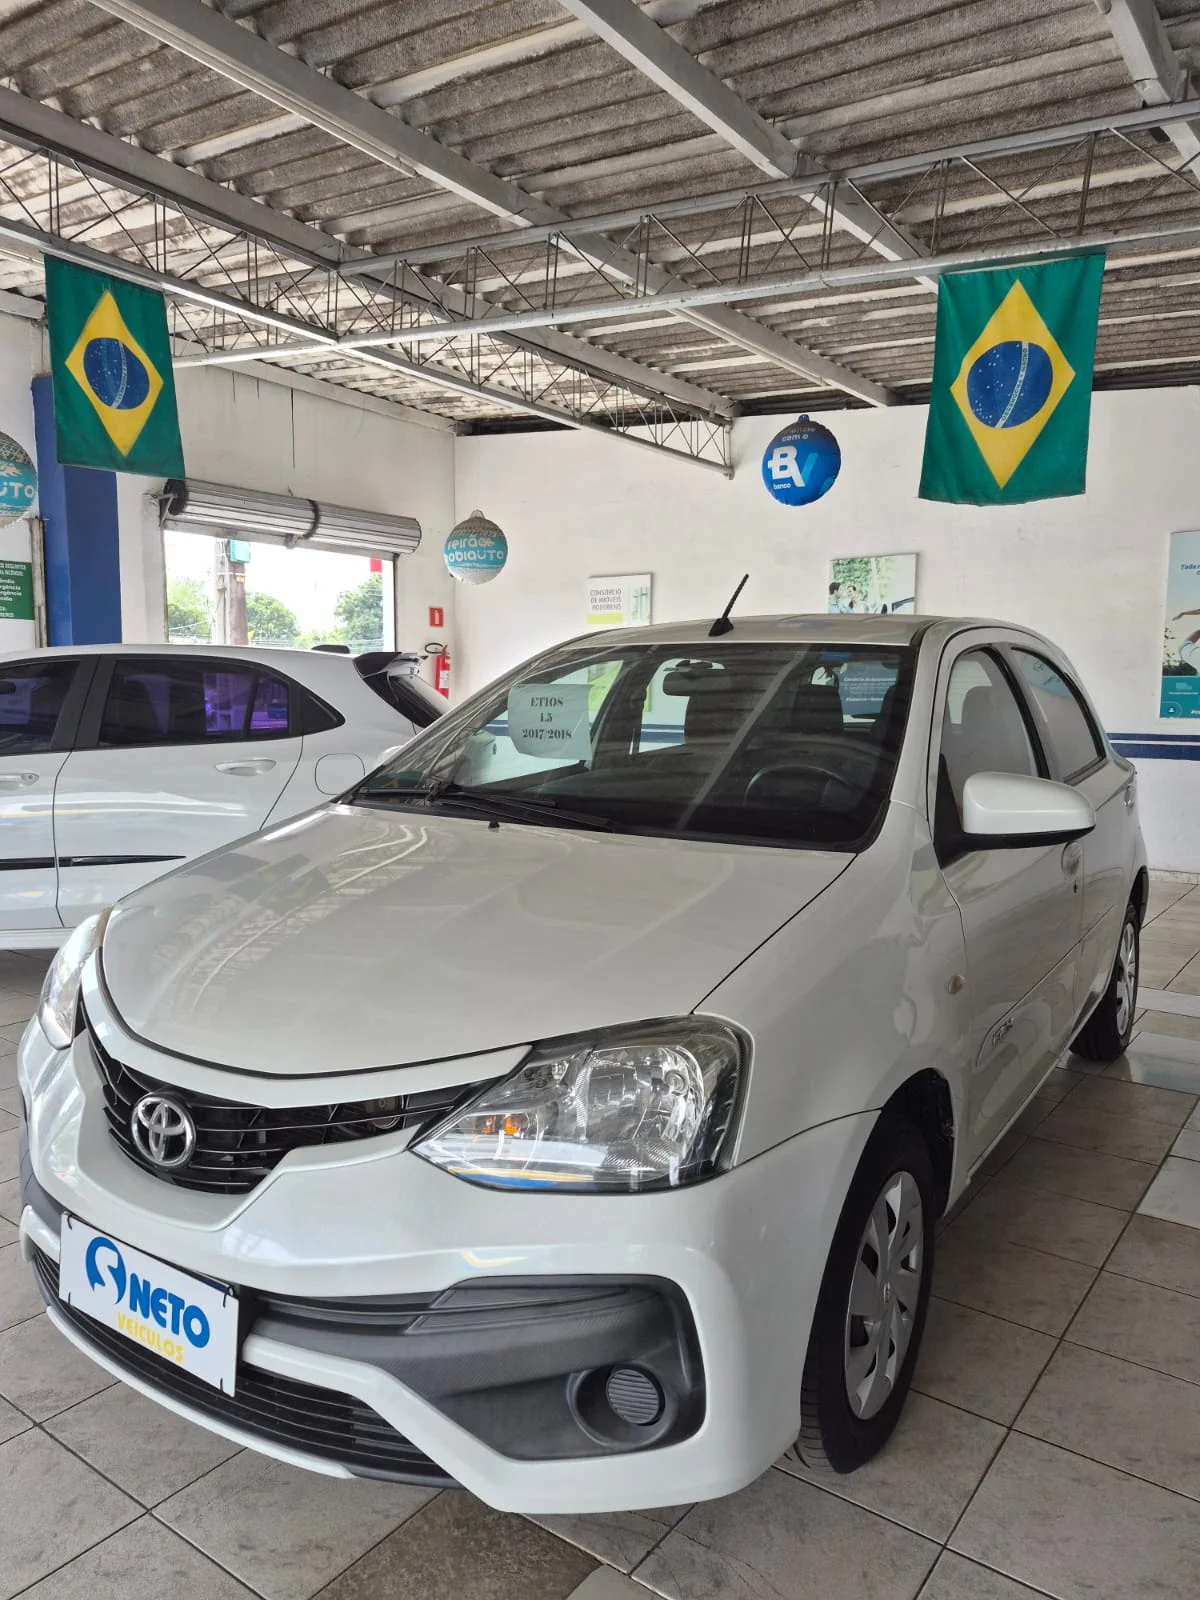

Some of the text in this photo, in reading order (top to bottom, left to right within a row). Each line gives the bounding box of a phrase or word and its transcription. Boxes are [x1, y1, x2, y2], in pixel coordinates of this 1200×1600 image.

[768, 446, 819, 487] BV
[530, 697, 563, 707] ETIOS
[540, 712, 553, 723] 1.5
[129, 1273, 210, 1348] NETO
